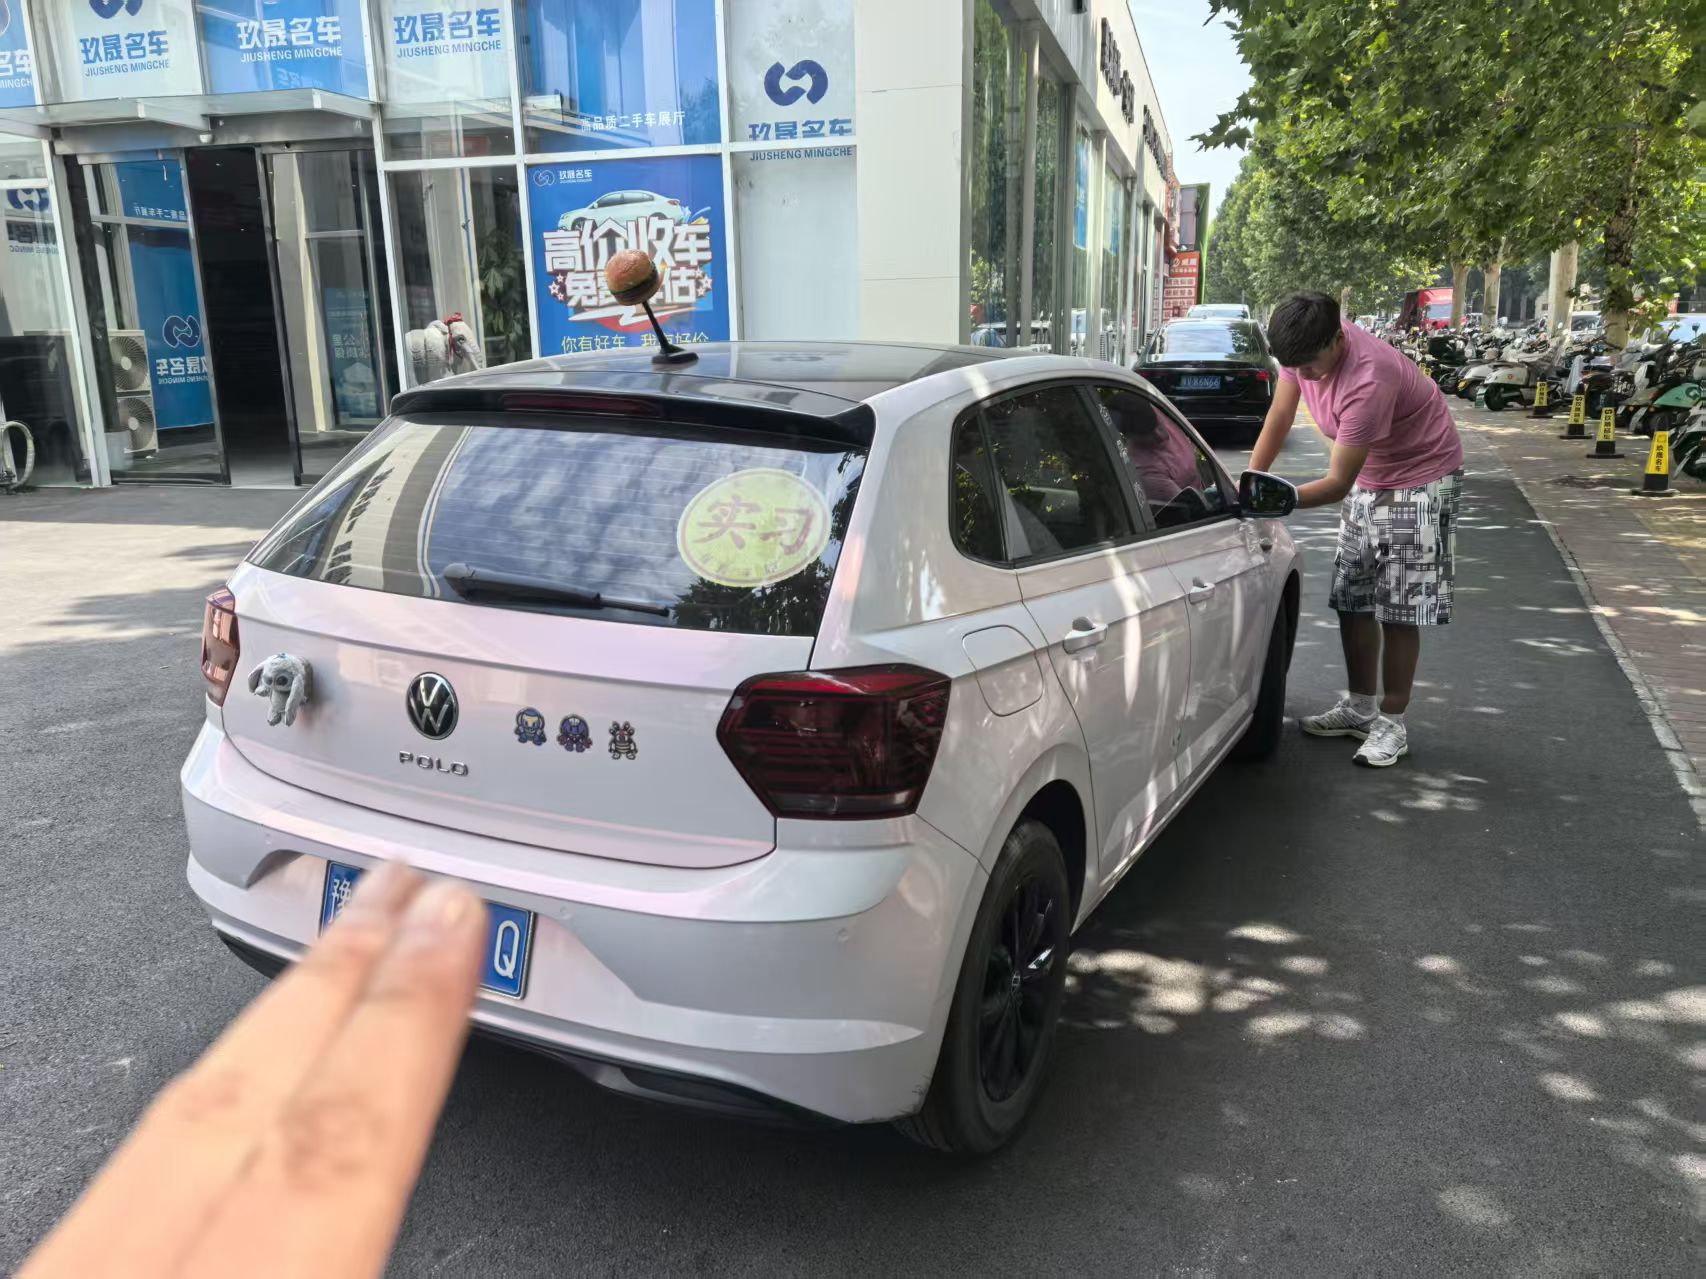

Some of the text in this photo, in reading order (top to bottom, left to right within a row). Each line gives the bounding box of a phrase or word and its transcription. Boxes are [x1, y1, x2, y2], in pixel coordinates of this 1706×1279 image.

[236, 15, 342, 50] 玖晟名车
[393, 8, 501, 45] 玖晟名车
[79, 30, 169, 65] 玖晟名车
[240, 46, 342, 63] JIUSHENG MINGCHE
[397, 39, 501, 58] JIUSHENG MINGCHE
[85, 58, 170, 77] JIUSHENG MINGCHE
[581, 111, 686, 132] 高品质二手车展厅
[750, 146, 853, 161] JIUSHENG MINGCHE
[542, 216, 713, 273] 高价收车
[564, 266, 697, 308] 免估
[561, 335, 626, 352] 你有好车
[692, 495, 815, 557] 实习
[398, 750, 469, 777] POLO
